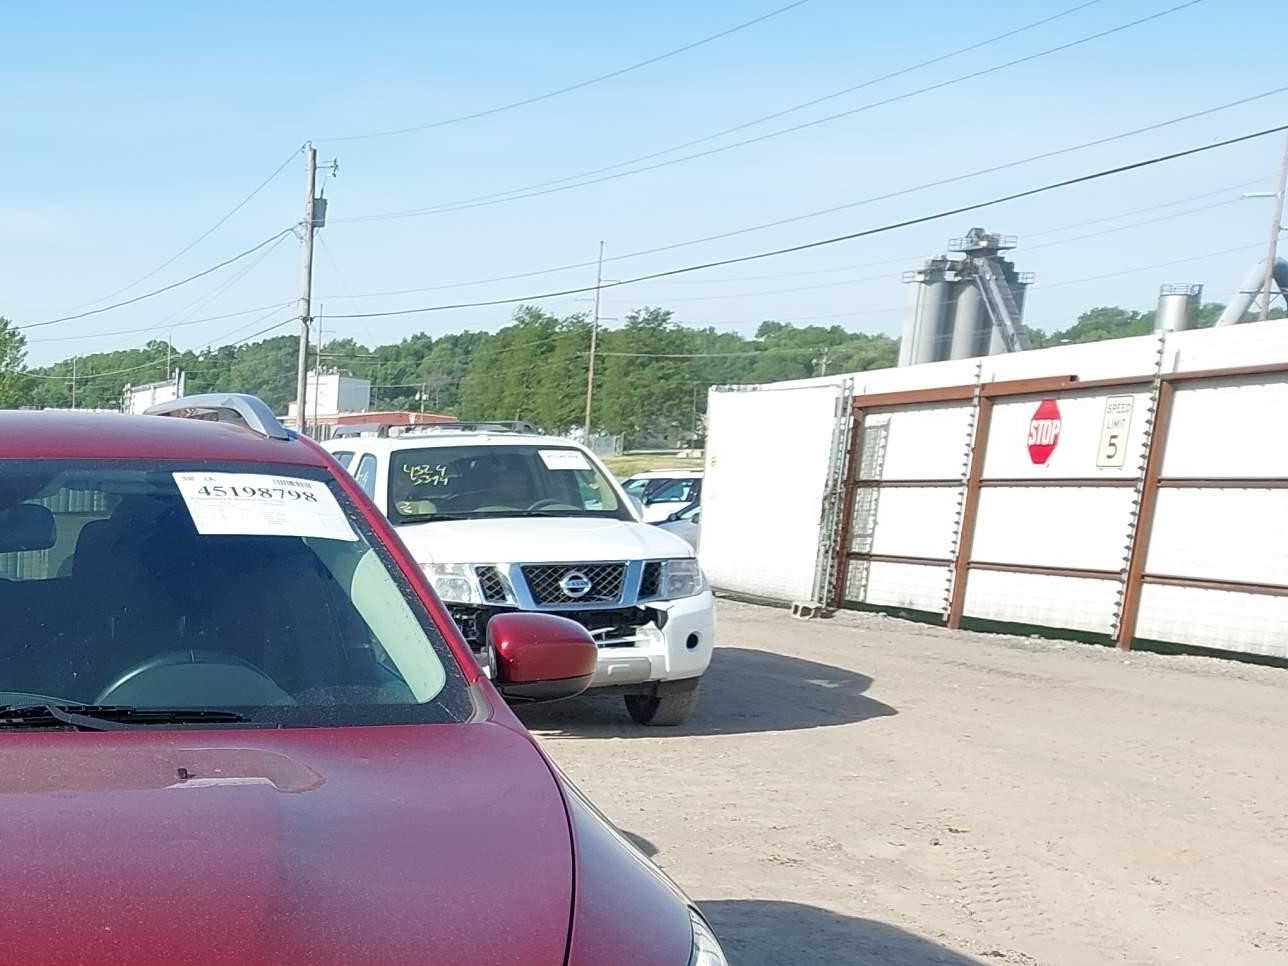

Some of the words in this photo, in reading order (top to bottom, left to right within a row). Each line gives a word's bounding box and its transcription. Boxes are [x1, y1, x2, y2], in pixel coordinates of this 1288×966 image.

[1107, 402, 1132, 414] SPEED
[1107, 416, 1126, 430] LIMIT
[1028, 419, 1061, 446] STOP
[1106, 434, 1119, 460] 5
[197, 485, 319, 503] 45198798
